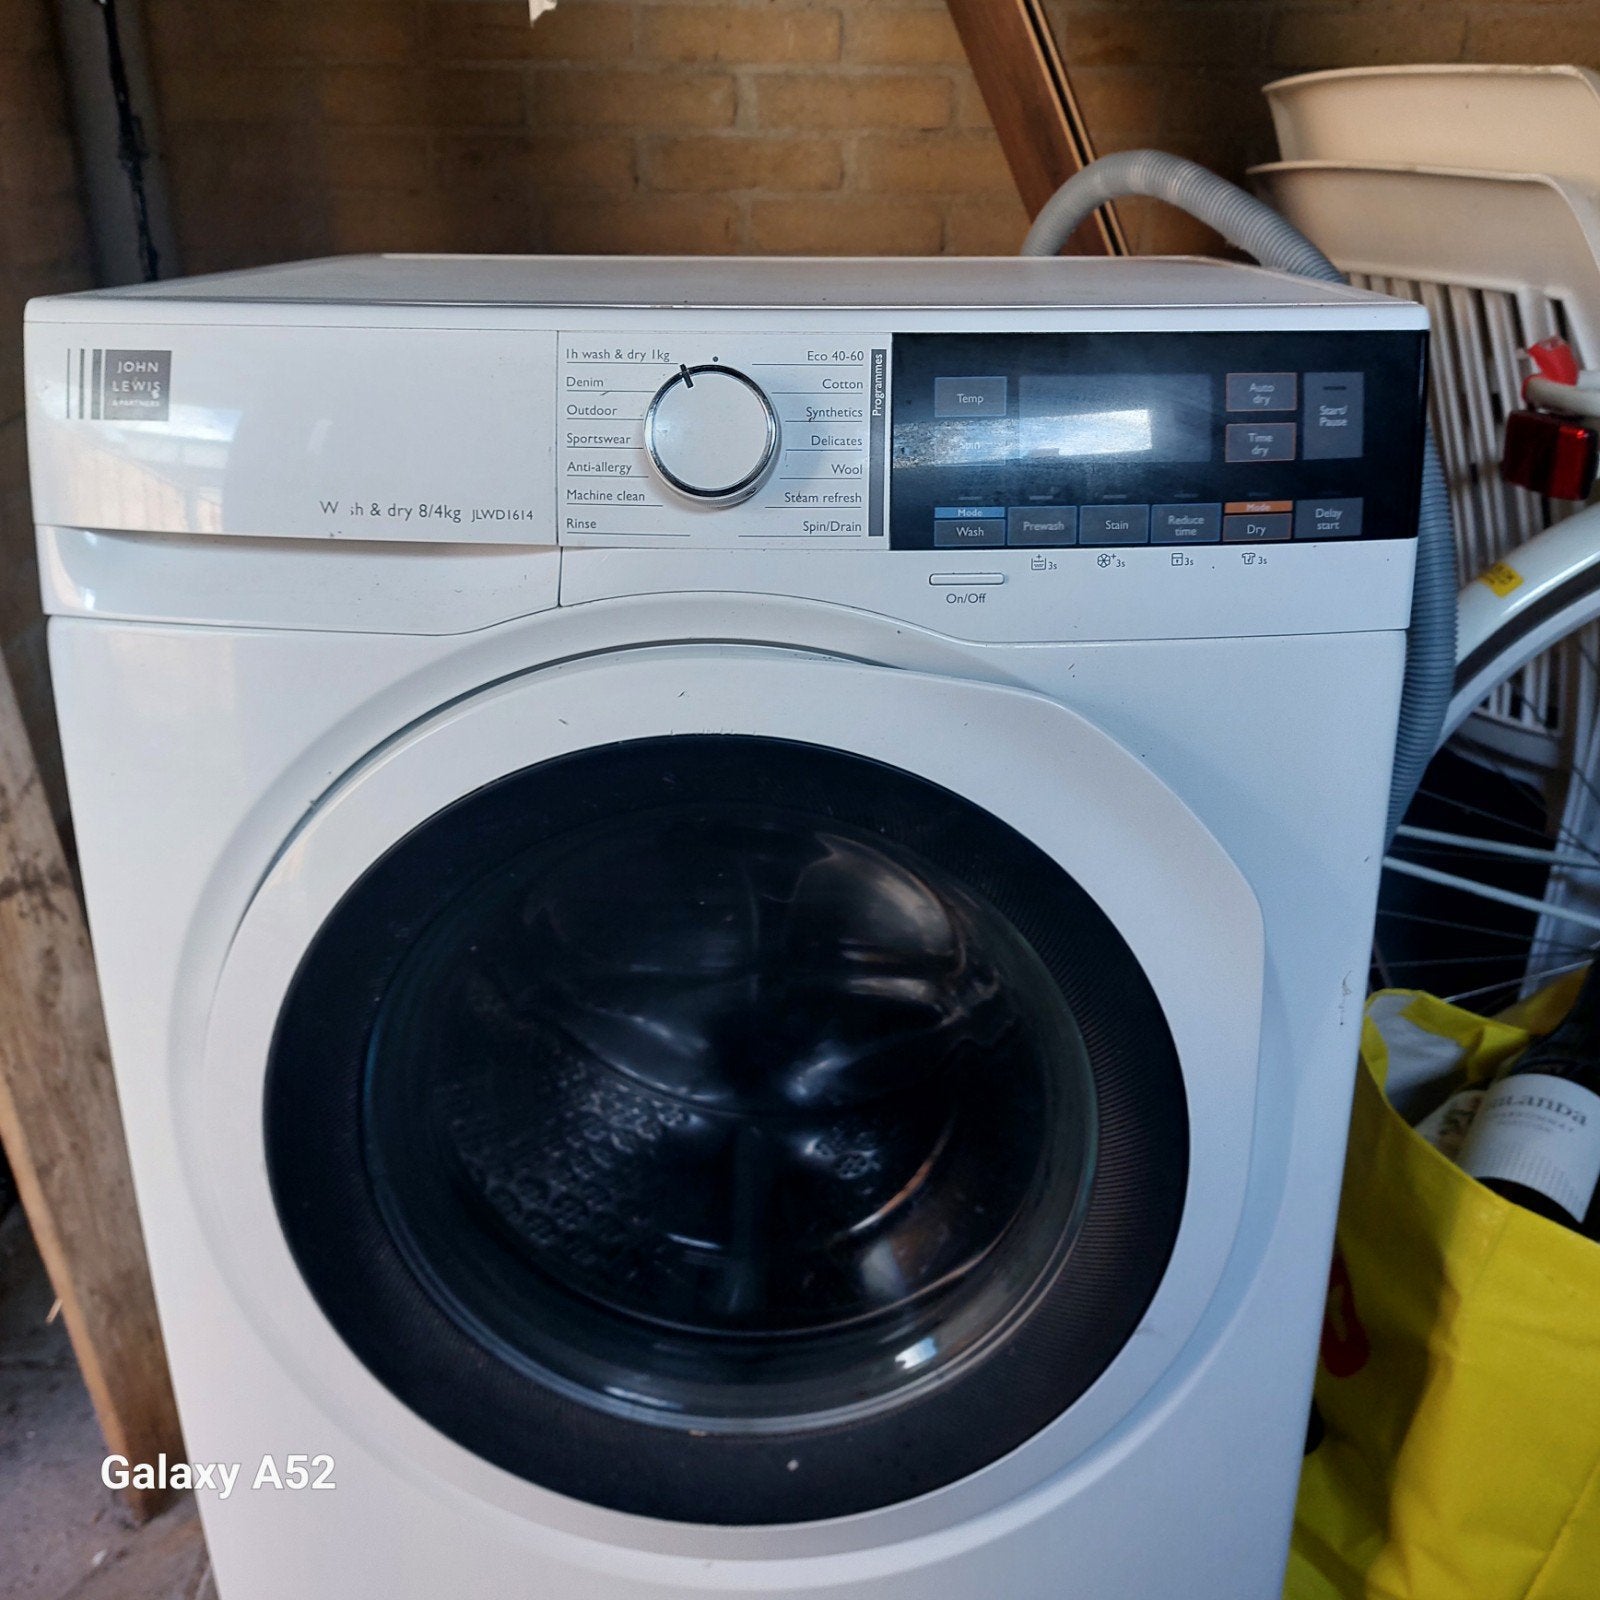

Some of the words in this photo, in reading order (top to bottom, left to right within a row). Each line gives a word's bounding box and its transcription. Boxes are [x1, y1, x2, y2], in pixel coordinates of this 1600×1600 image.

[582, 349, 611, 360] wash
[614, 349, 623, 360] &
[627, 349, 647, 362] dry
[652, 349, 670, 362] 1kg
[807, 350, 828, 361] Eco
[832, 350, 864, 361] 40-60
[117, 360, 159, 373] JOHN
[112, 380, 161, 393] LEWIS
[566, 376, 604, 387] Denim
[822, 379, 864, 390] Cotton
[872, 353, 885, 417] Programmes
[1248, 383, 1275, 393] Auto
[956, 392, 984, 406] Temp
[1252, 394, 1271, 406] dry
[566, 404, 618, 416] Outdoor
[806, 406, 863, 420] Synthetics
[1318, 417, 1348, 427] Pause
[566, 433, 631, 447] Sportswear
[811, 435, 863, 446] Delicates
[1248, 432, 1274, 443] Time
[1251, 445, 1269, 457] dry
[566, 461, 632, 475] Anti-allergy
[831, 464, 863, 475] Wool
[566, 490, 613, 501] Machine
[616, 490, 645, 501] clean
[784, 491, 819, 503] Steam
[822, 491, 862, 503] refresh
[319, 500, 364, 517] Wsh
[370, 502, 381, 517] &
[387, 503, 413, 521] dry
[418, 503, 462, 524] 8/4kg
[471, 509, 534, 523] JLWD1614
[957, 508, 983, 518] Mode
[1246, 503, 1270, 512] Mode
[1315, 508, 1343, 520] Delay
[566, 518, 597, 529] Rinse
[1105, 520, 1129, 531] Stain
[1167, 515, 1205, 526] Reduce
[1316, 521, 1340, 531] start
[802, 520, 862, 534] Spin/Drain
[956, 526, 985, 537] Wash
[1022, 521, 1065, 532] Prewash
[1174, 526, 1198, 537] time
[1246, 524, 1266, 537] Dry
[1048, 561, 1058, 570] 3s
[1115, 559, 1126, 568] 3s
[1184, 557, 1194, 566] 3s
[1257, 556, 1267, 565] 3s
[945, 592, 987, 604] On/Off
